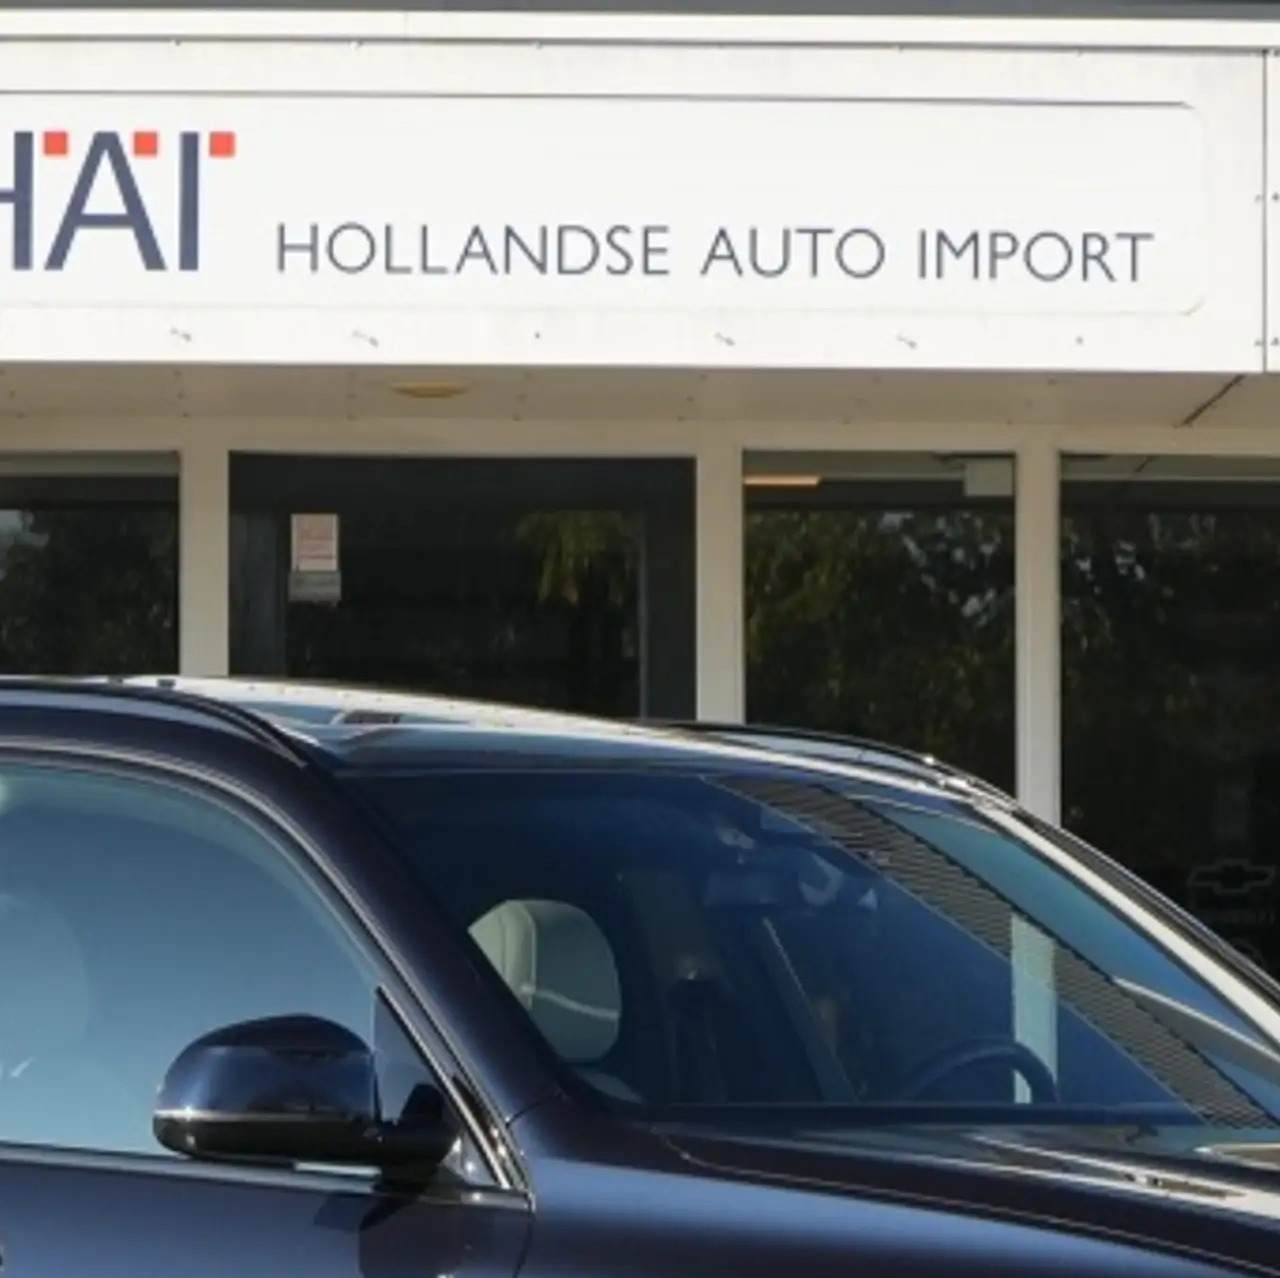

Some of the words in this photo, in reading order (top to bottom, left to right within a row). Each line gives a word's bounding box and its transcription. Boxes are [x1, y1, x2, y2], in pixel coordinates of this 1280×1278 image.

[276, 221, 671, 277] HOLLANDSE
[698, 226, 887, 281] AUTO
[917, 228, 1156, 284] IMPORT
